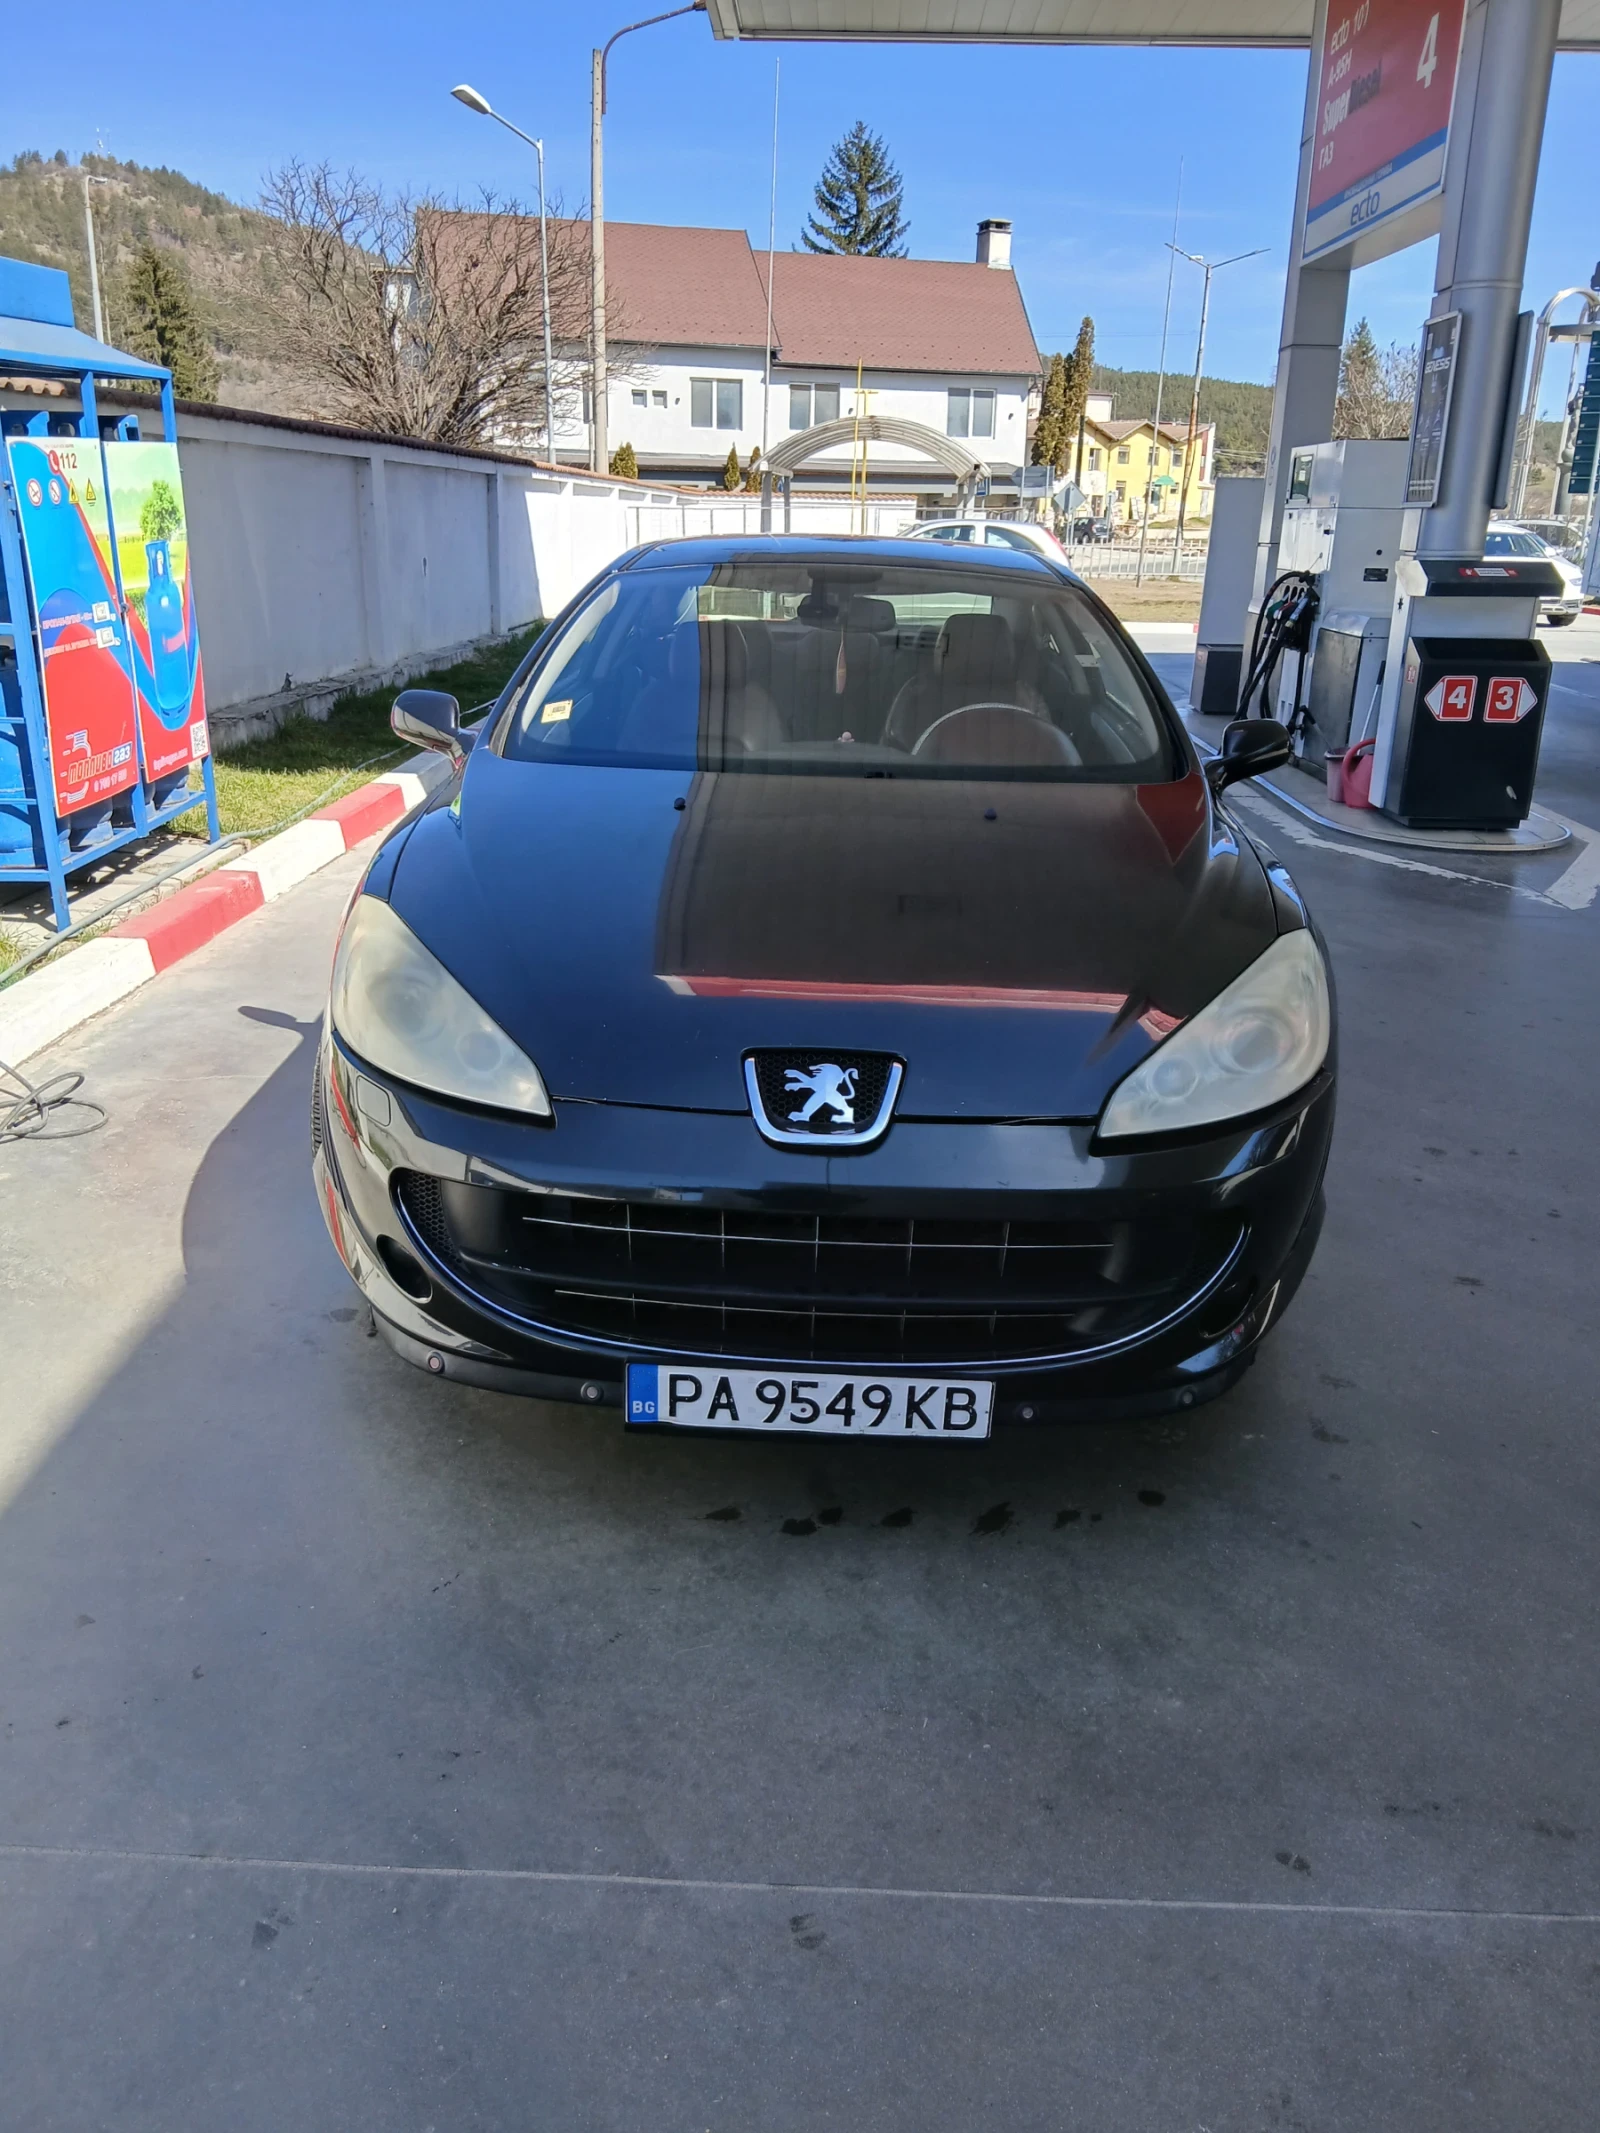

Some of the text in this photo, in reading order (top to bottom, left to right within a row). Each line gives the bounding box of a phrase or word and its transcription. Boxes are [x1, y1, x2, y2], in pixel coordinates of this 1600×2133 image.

[1330, 18, 1350, 55] ecto
[1416, 12, 1439, 89] 4
[1318, 141, 1334, 171] ГАЗ
[1350, 189, 1380, 226] ecto
[60, 452, 78, 469] 112
[1447, 686, 1467, 709] 4
[1495, 686, 1514, 710] 3
[632, 1400, 655, 1414] BG
[669, 1373, 978, 1430] PA 9549 KB
